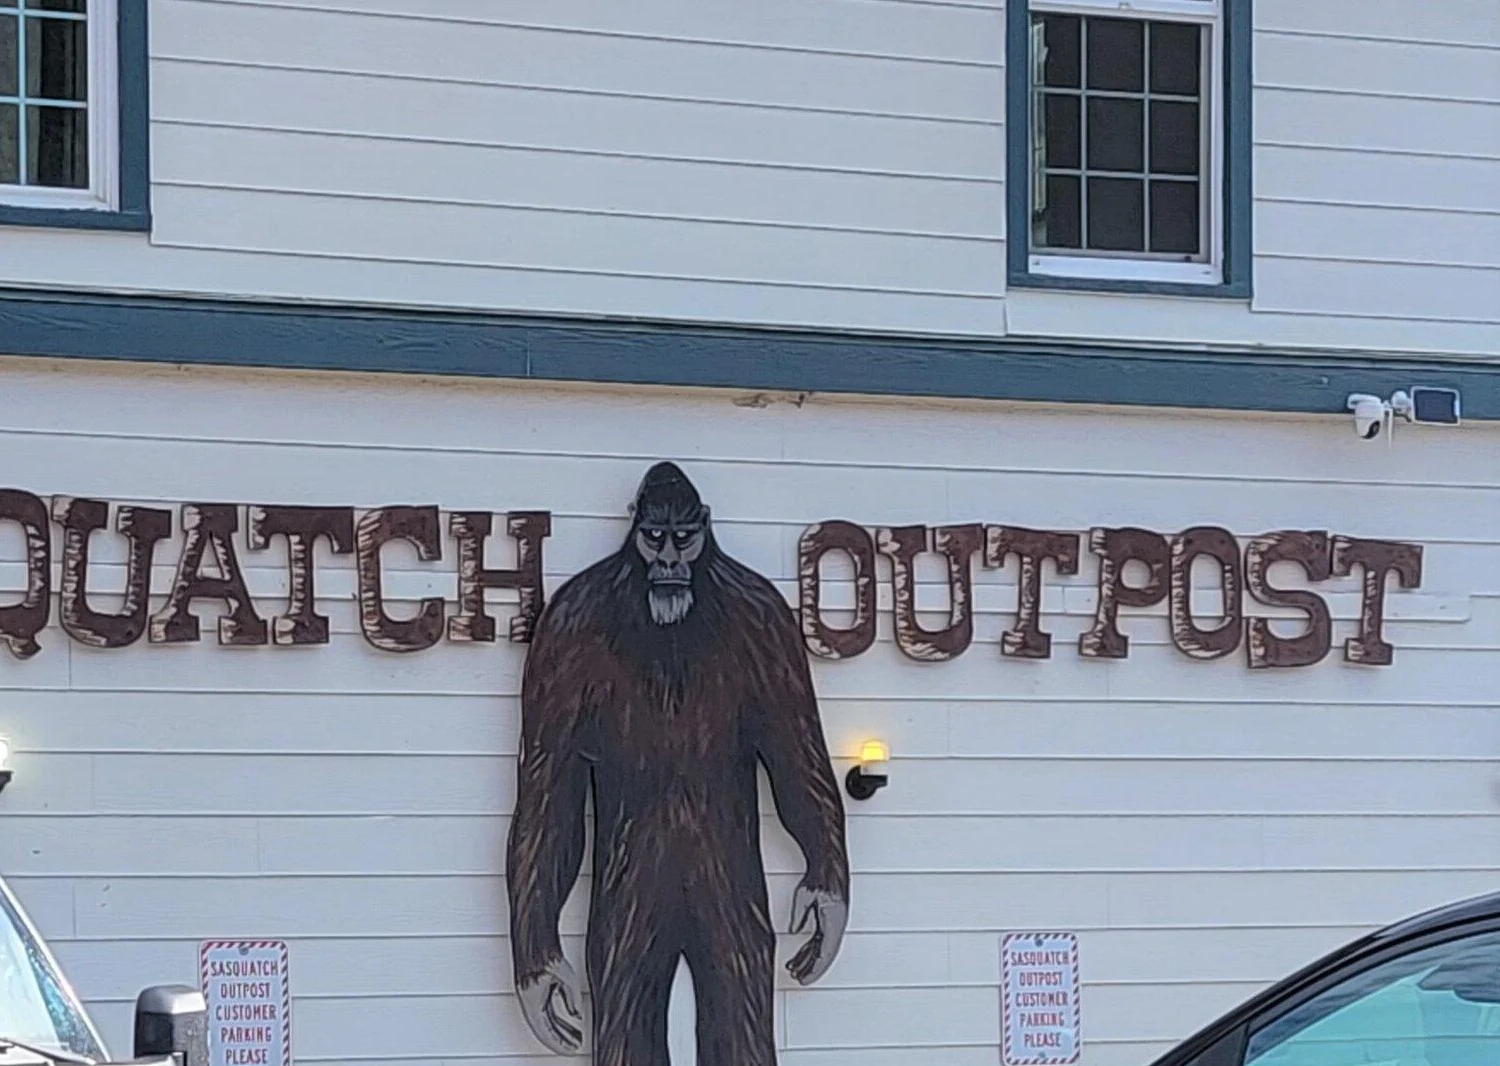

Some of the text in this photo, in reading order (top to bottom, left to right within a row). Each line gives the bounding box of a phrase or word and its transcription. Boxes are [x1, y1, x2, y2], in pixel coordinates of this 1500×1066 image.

[799, 520, 1423, 668] OUTPOST
[1010, 951, 1069, 966] SASQUATCH
[210, 961, 278, 976] SASQUATCH
[1020, 972, 1063, 986] OUTPOST
[220, 983, 270, 998] OUTPOST
[1015, 991, 1068, 1007] CUSTOMER
[216, 1005, 277, 1021] CUSTOMER
[1020, 1012, 1064, 1027] PARKING
[220, 1027, 272, 1042] PARKING
[1024, 1032, 1062, 1048] PLEASE
[226, 1049, 268, 1065] PLEASE
